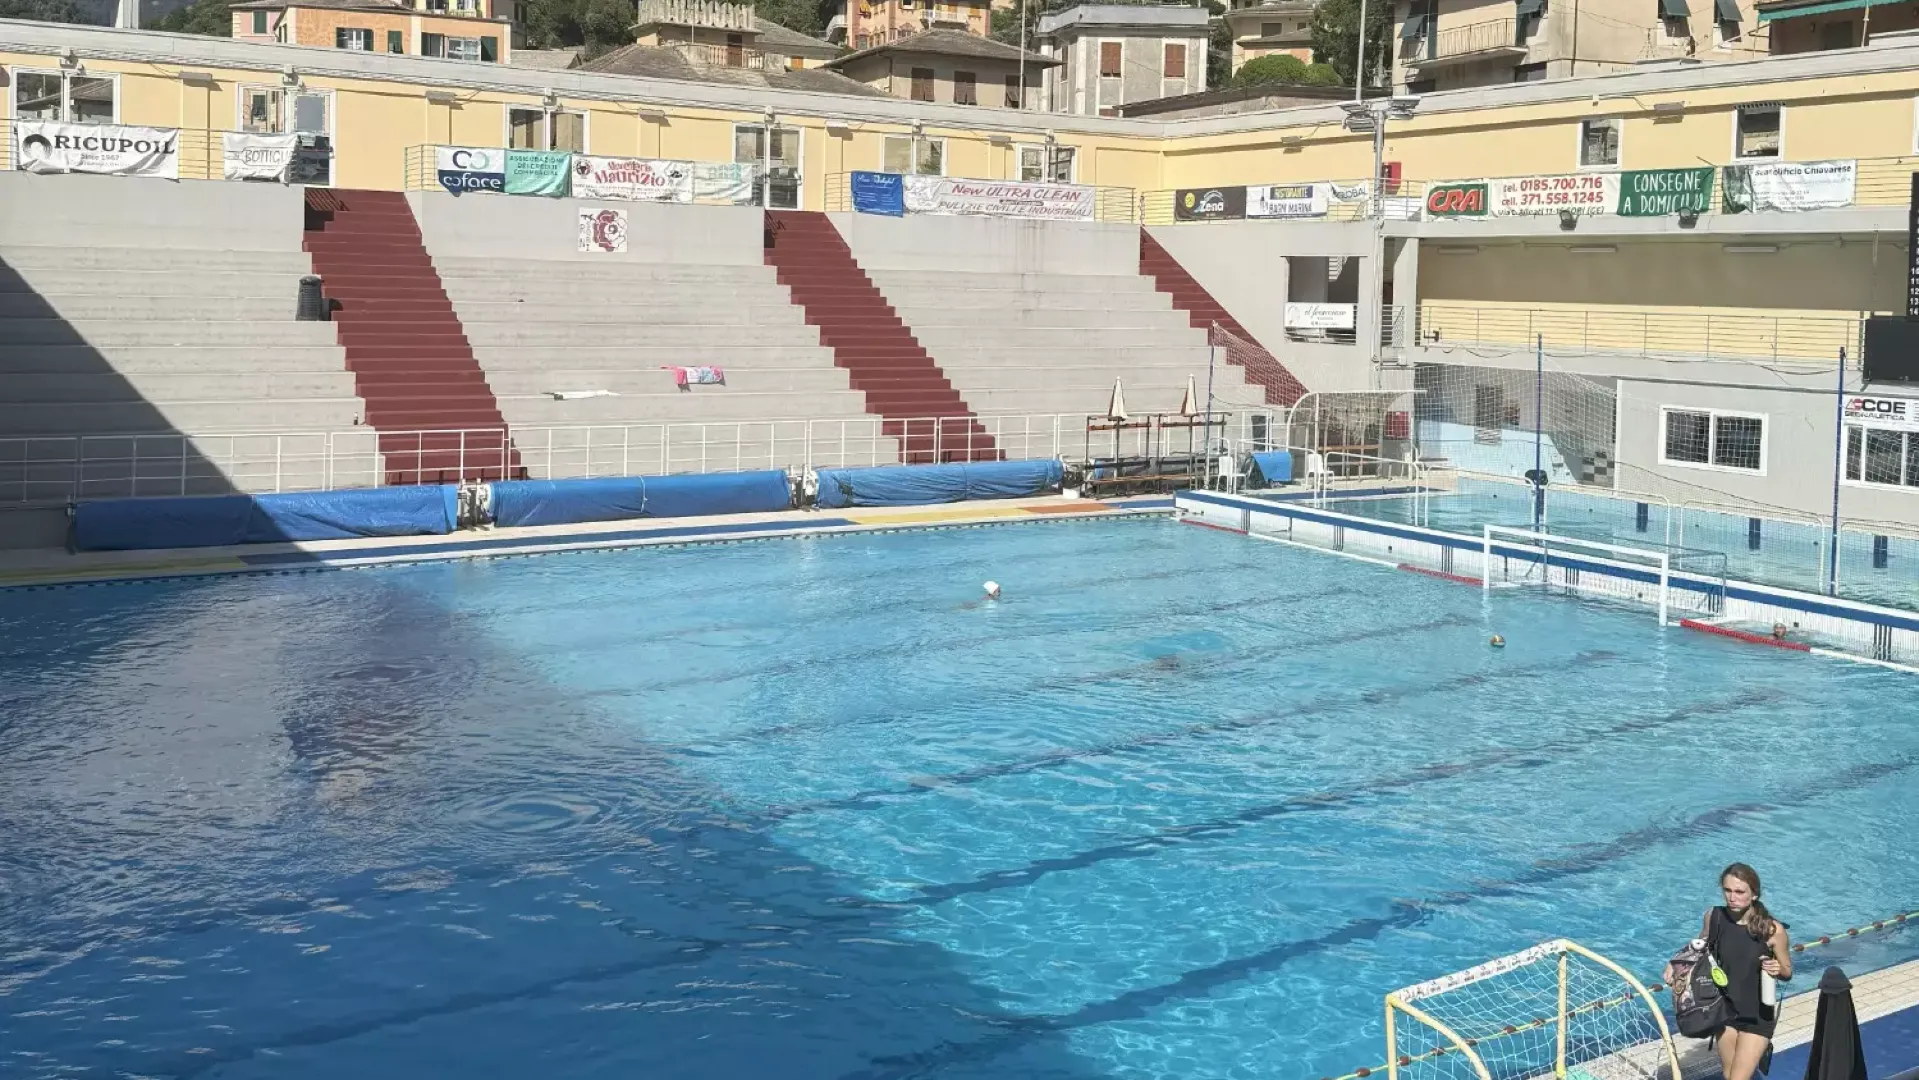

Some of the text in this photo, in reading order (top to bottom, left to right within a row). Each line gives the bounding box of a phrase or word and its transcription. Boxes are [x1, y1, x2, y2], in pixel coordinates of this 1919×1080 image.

[54, 135, 175, 155] RICUPOIL
[594, 169, 666, 187] Maurizio
[1804, 165, 1852, 175] Chiavarese
[443, 173, 502, 189] coface
[1503, 177, 1603, 194] tel. 0185.700.716
[1634, 171, 1702, 192] CONSEGNE
[951, 184, 1082, 201] New ULTRA CLEAN
[1428, 188, 1485, 213] CRAI
[1520, 192, 1604, 206] 371.558.1245
[938, 201, 983, 211] PULIZIE
[1194, 200, 1224, 213] Zena
[1623, 197, 1633, 213] A
[1909, 297, 1919, 305] 13
[1909, 307, 1919, 316] 14
